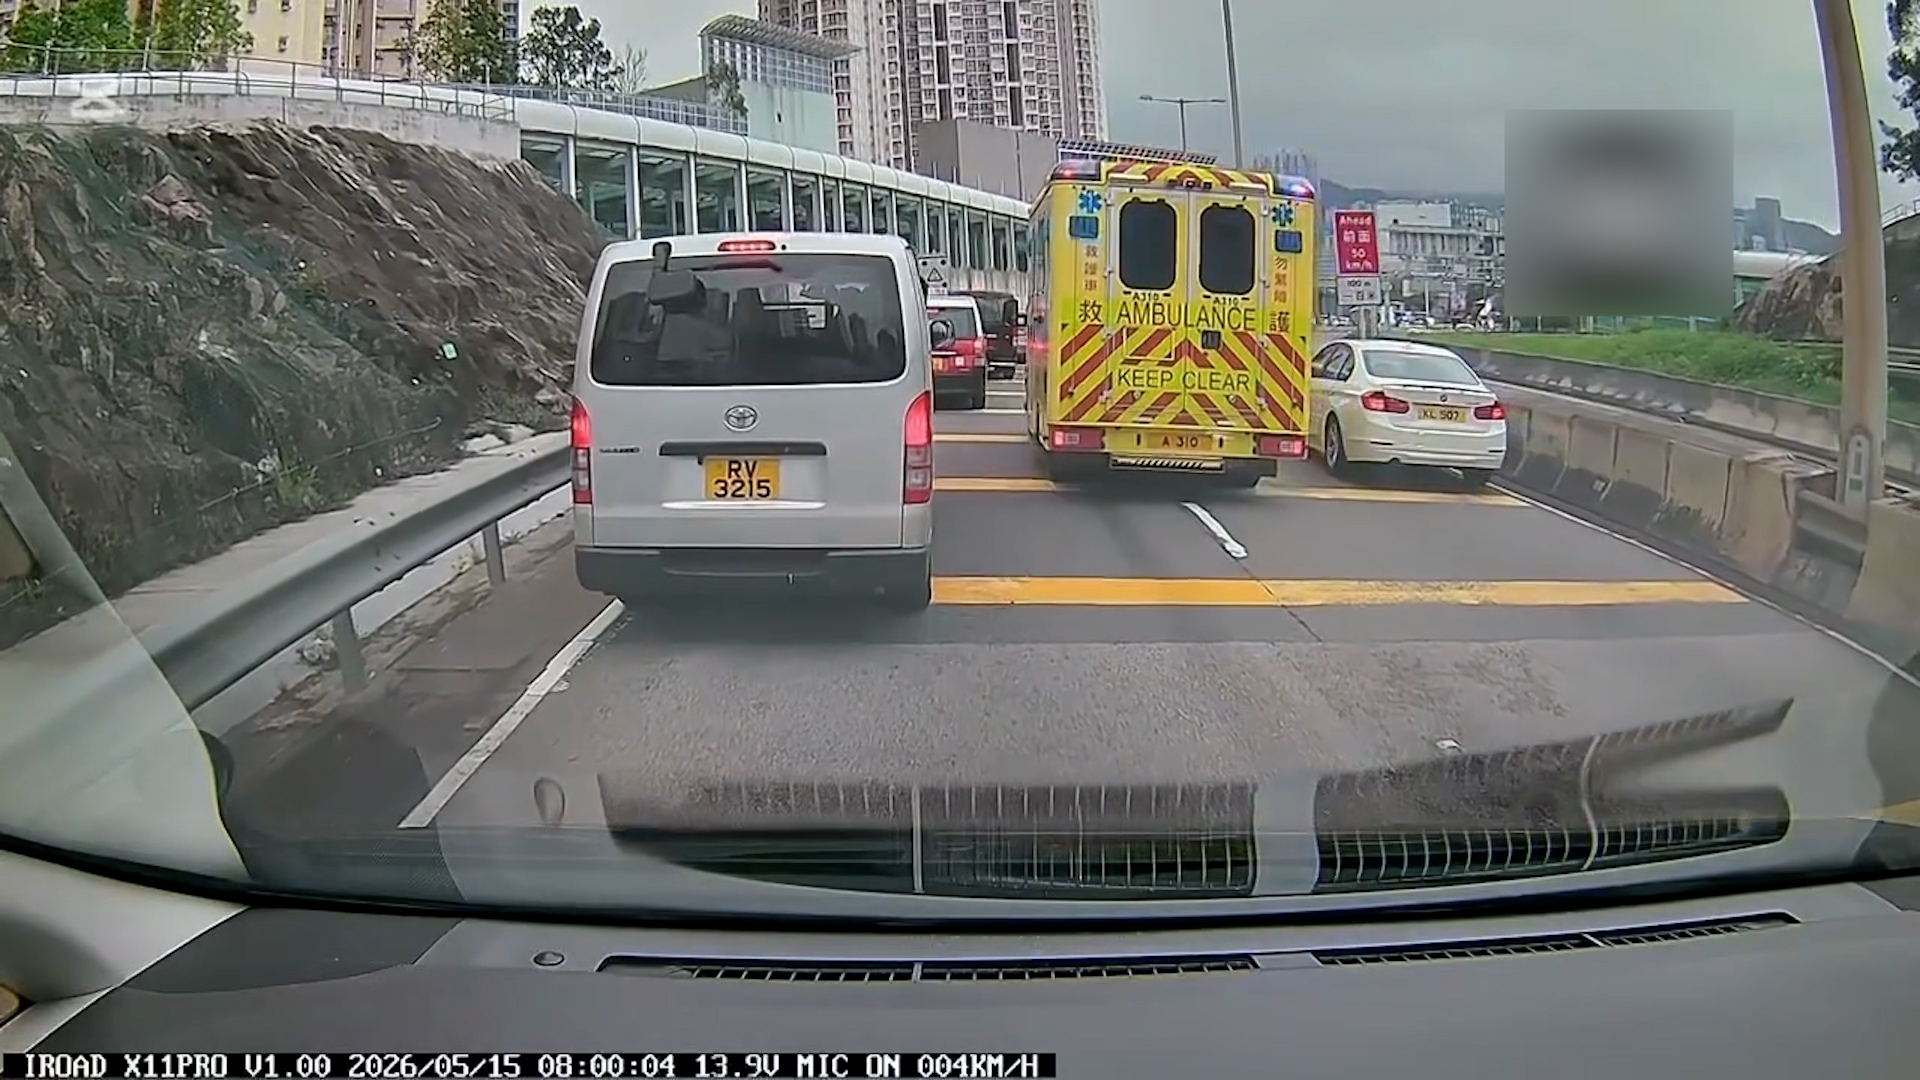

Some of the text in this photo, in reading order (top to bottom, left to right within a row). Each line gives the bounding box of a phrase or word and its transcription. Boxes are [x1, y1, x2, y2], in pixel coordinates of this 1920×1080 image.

[1339, 215, 1372, 226] Ahead
[1343, 230, 1371, 243] 前面
[1351, 248, 1367, 259] 50
[1345, 260, 1373, 271] km/h
[1132, 292, 1160, 301] A310
[1213, 296, 1240, 306] A310
[1343, 291, 1374, 301] 一百米
[1078, 299, 1103, 323] 救
[1116, 301, 1256, 331] AMBULANCE
[1118, 368, 1250, 392] KEEP CLEAR
[1422, 408, 1459, 421] KL 507
[1162, 436, 1198, 448] A 310
[727, 460, 758, 480] RV
[714, 480, 771, 499] 3215
